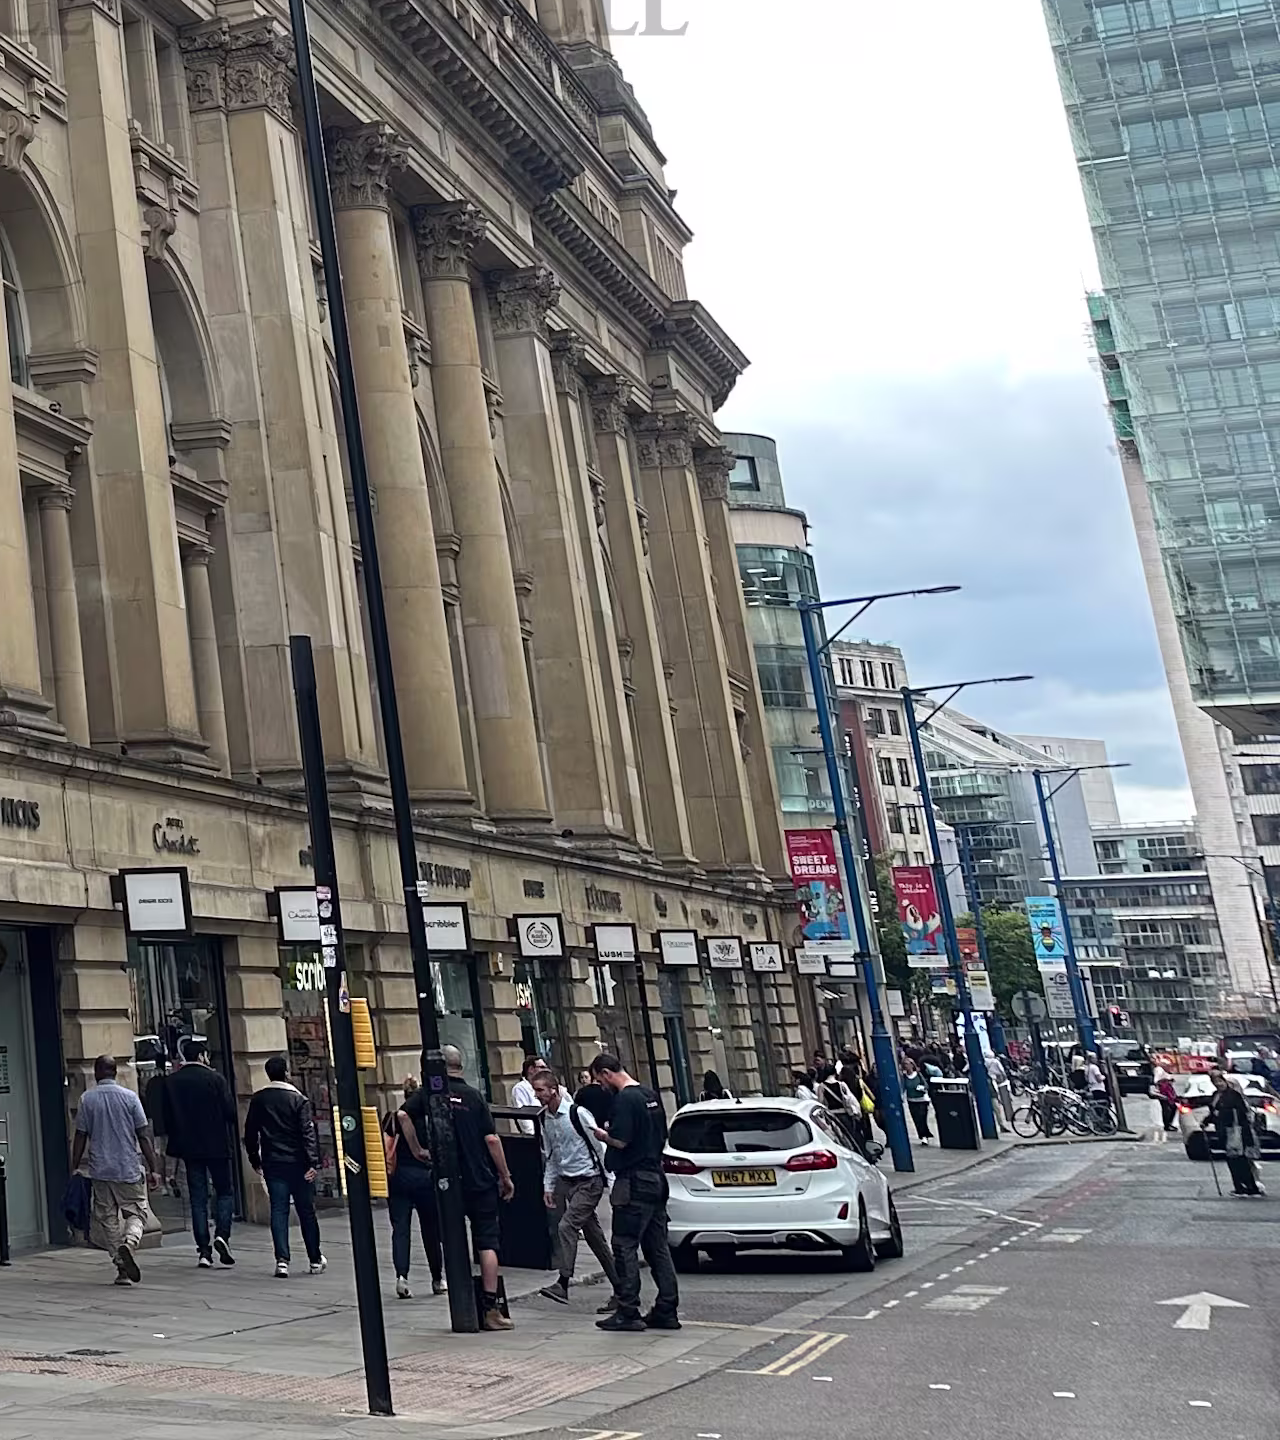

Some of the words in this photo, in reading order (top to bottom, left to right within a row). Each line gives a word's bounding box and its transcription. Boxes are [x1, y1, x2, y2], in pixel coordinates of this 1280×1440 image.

[0, 797, 40, 830] KICKS
[792, 855, 828, 865] SWEET
[794, 864, 837, 875] DREAMS
[296, 952, 327, 991] scrib
